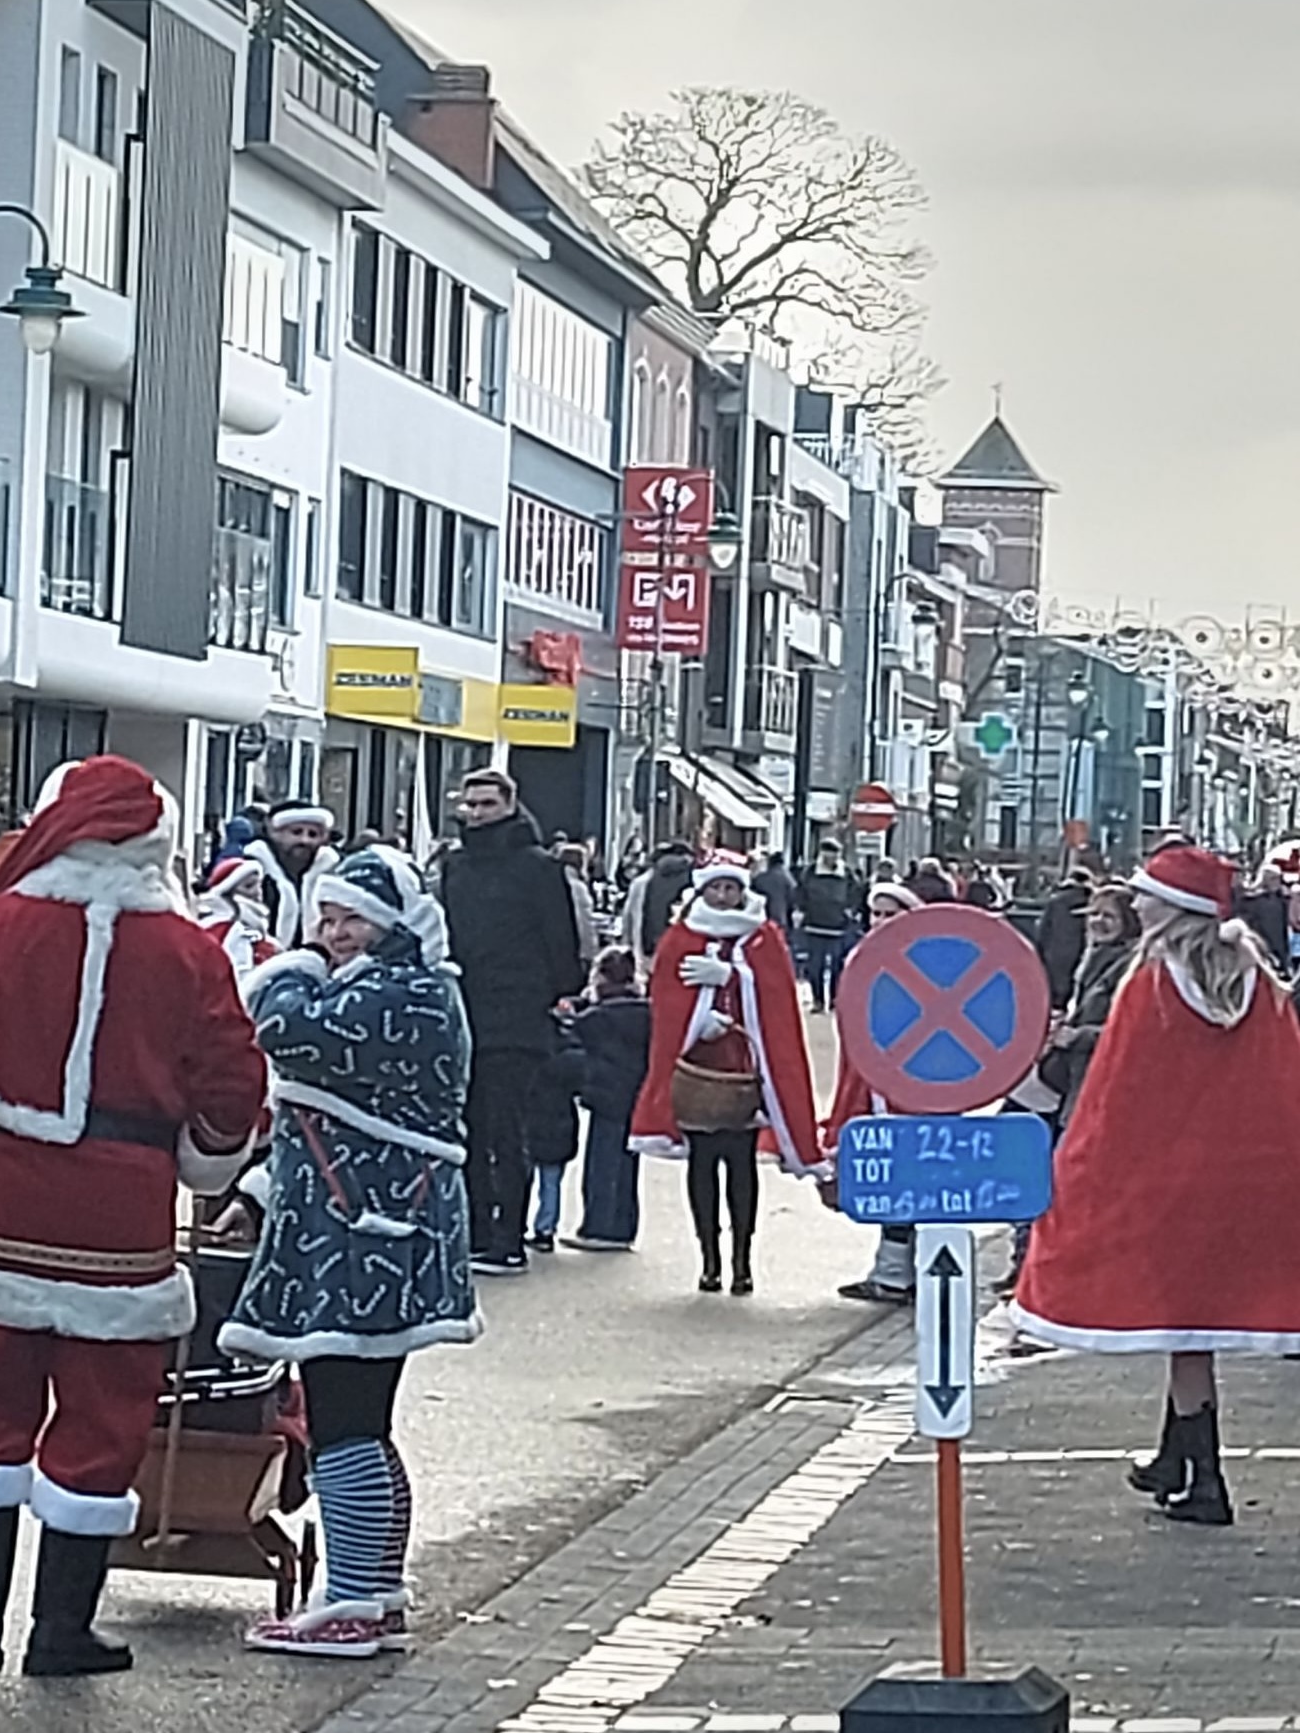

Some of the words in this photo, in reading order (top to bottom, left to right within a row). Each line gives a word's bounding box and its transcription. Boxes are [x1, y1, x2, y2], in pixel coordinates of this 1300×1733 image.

[850, 1125, 894, 1152] VAN
[852, 1158, 894, 1184] TOT
[852, 1194, 892, 1217] van
[940, 1187, 972, 1214] tot
